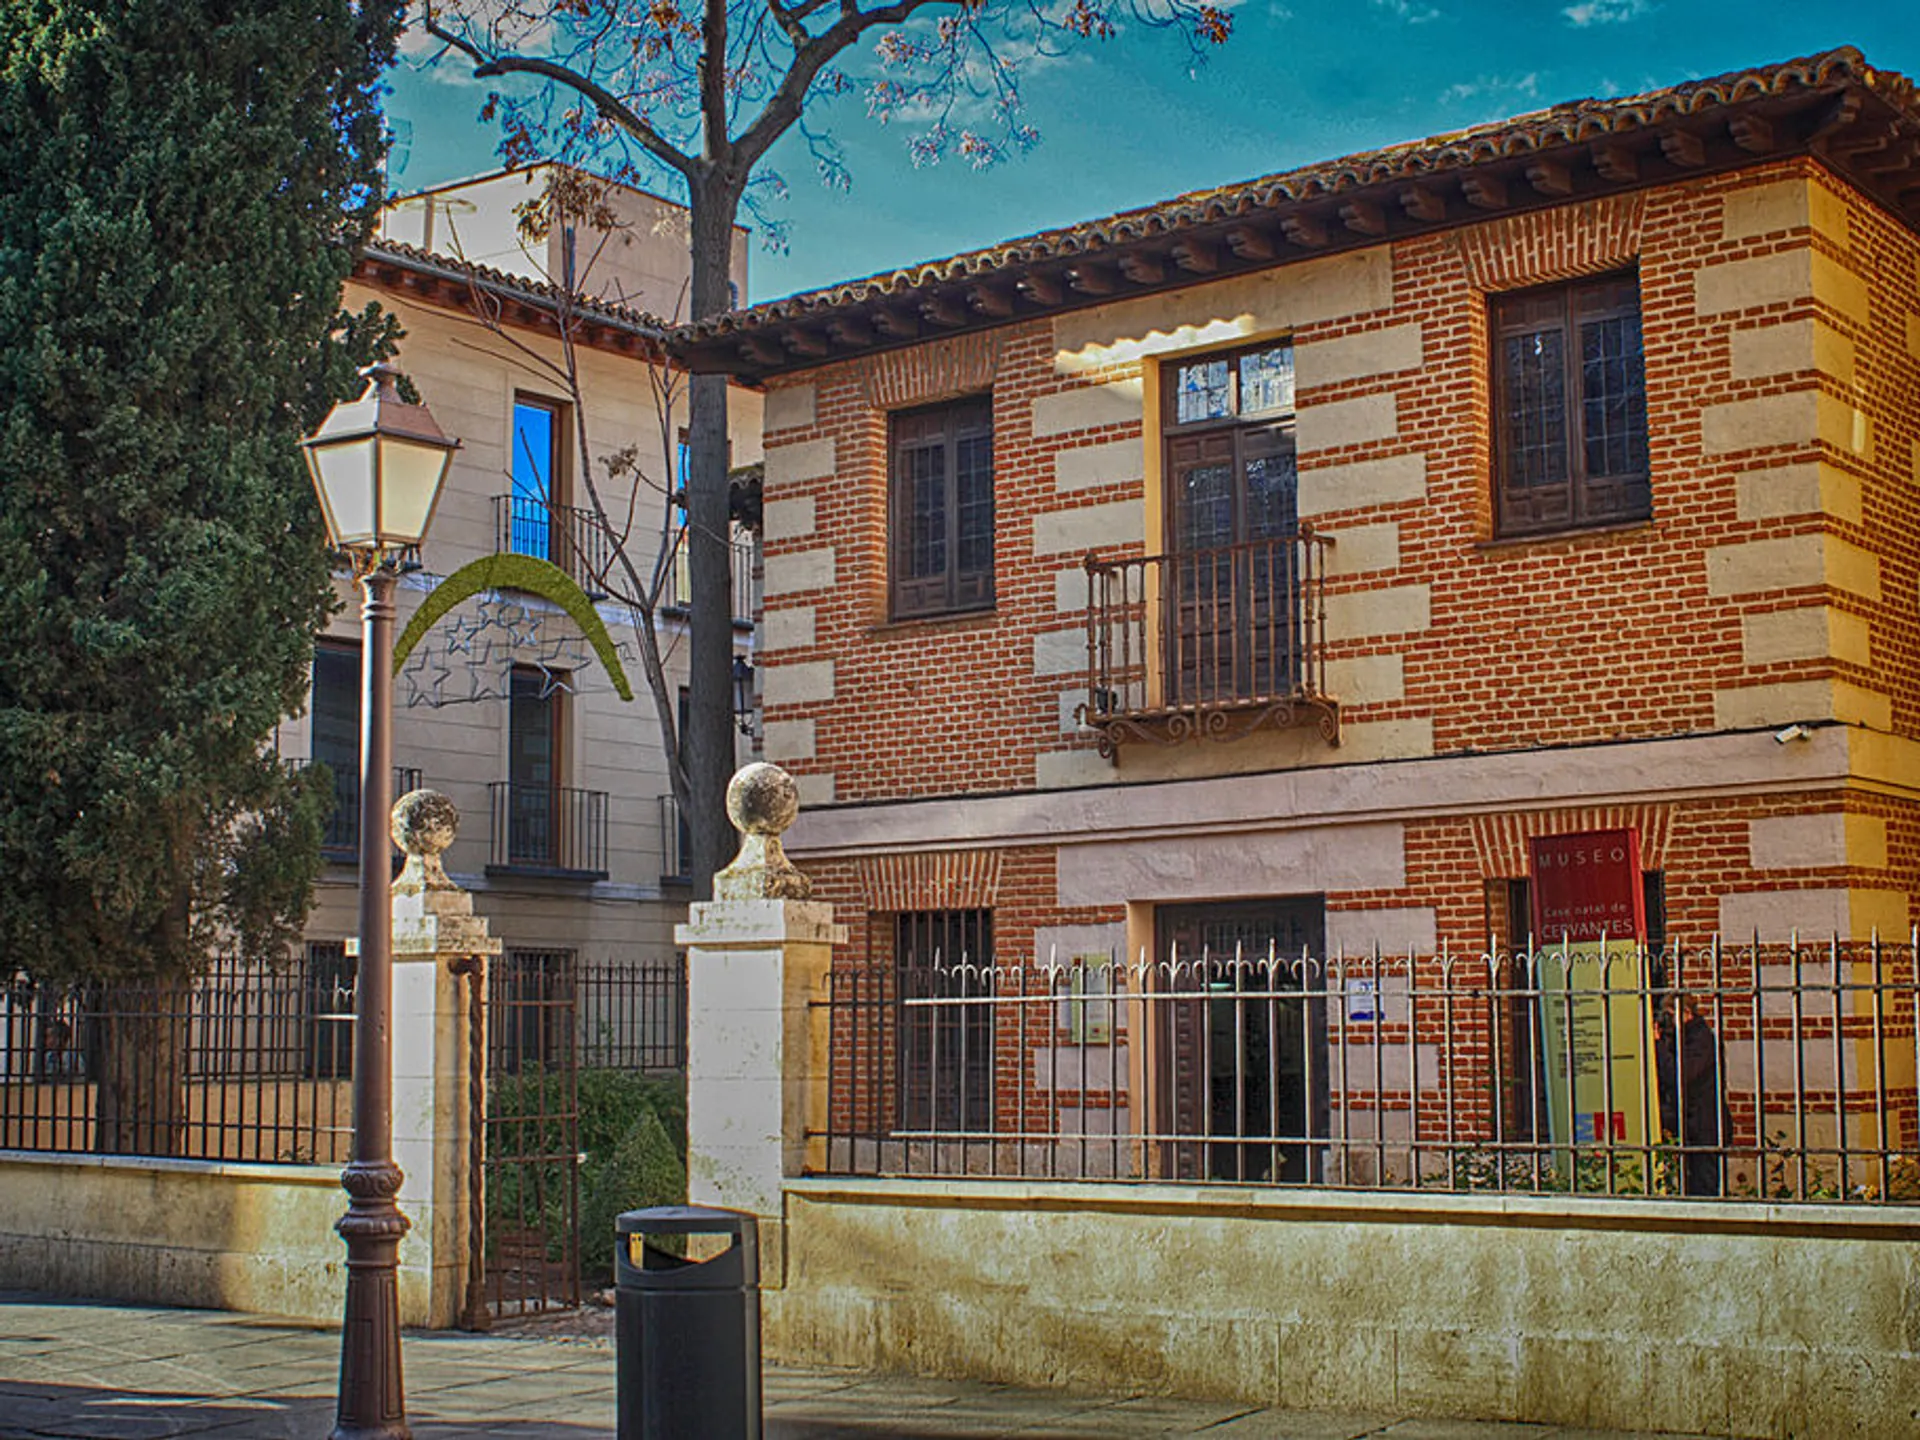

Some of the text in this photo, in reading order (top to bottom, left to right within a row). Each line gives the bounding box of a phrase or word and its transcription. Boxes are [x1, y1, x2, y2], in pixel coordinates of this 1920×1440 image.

[1539, 848, 1624, 867] MUSEO
[1574, 904, 1606, 915] natal
[1611, 901, 1627, 913] de
[1541, 918, 1633, 938] CERVANTES
